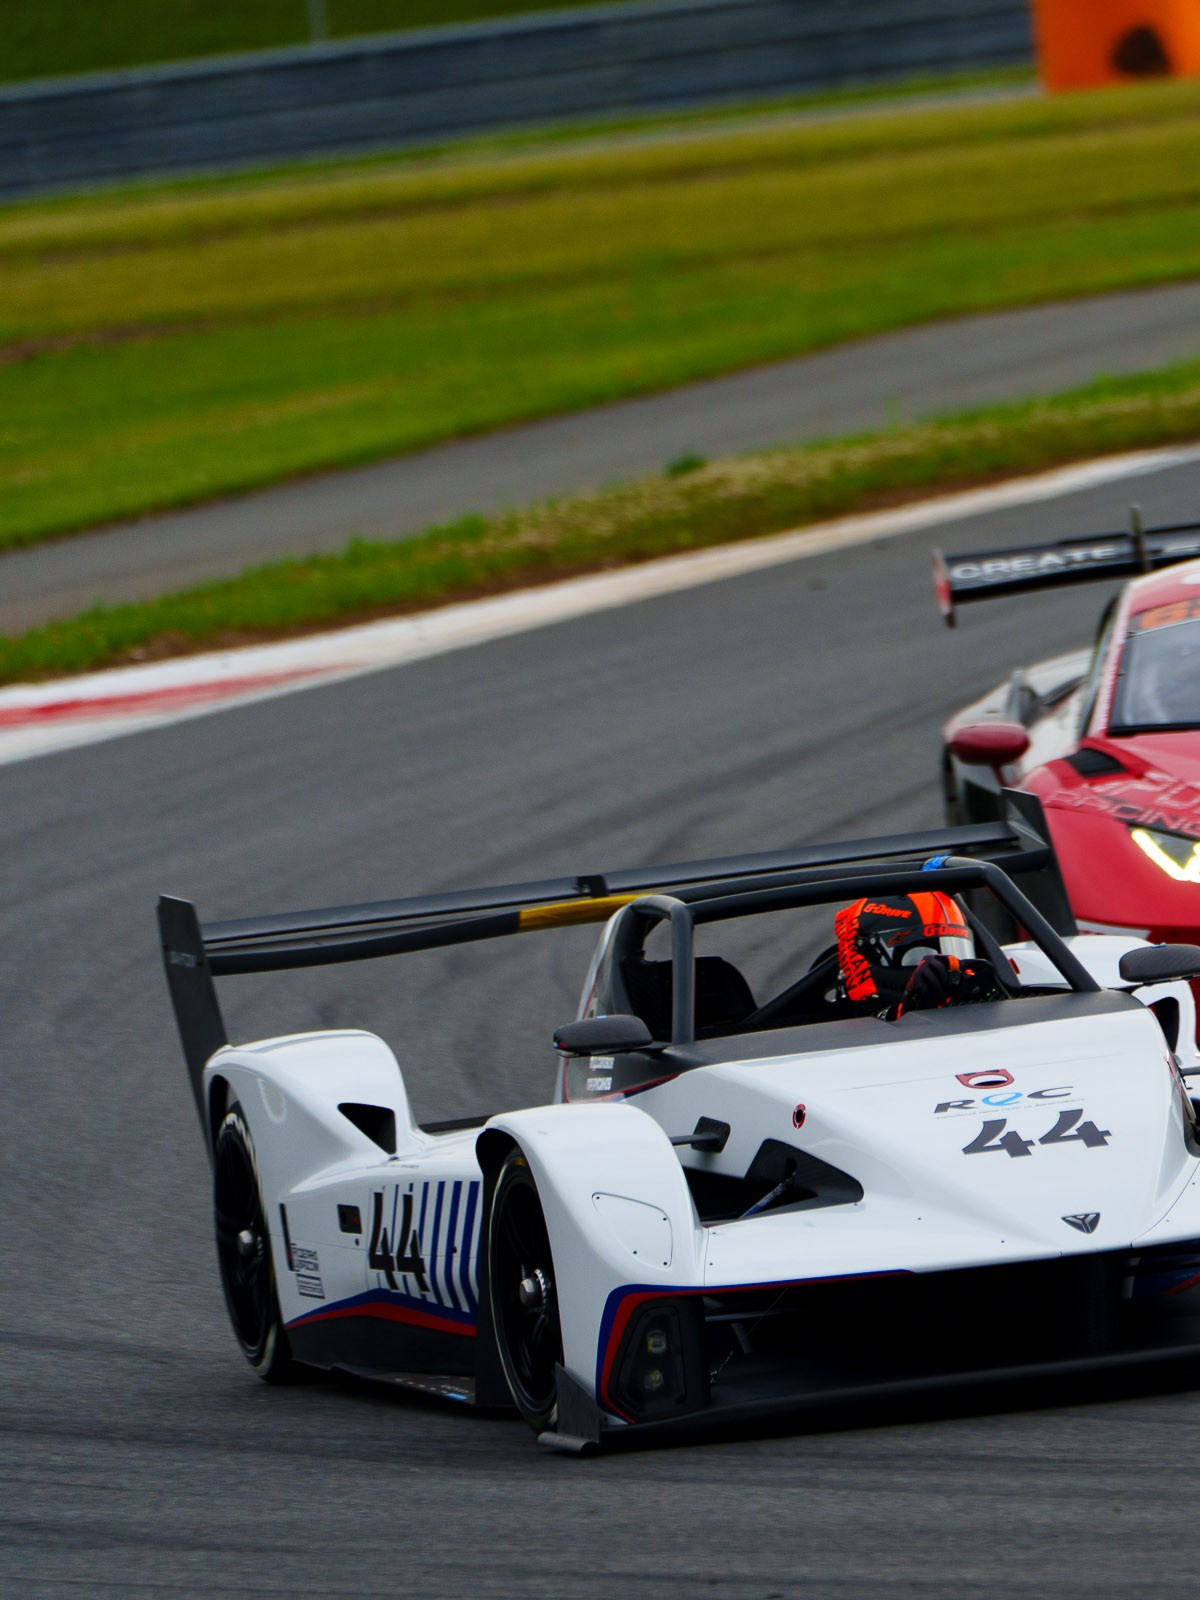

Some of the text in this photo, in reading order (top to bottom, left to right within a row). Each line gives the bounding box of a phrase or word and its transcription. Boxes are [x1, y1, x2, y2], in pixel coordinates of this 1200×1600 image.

[950, 545, 1117, 579] CREATE
[961, 1109, 1112, 1158] 44
[369, 1191, 430, 1292] 44
